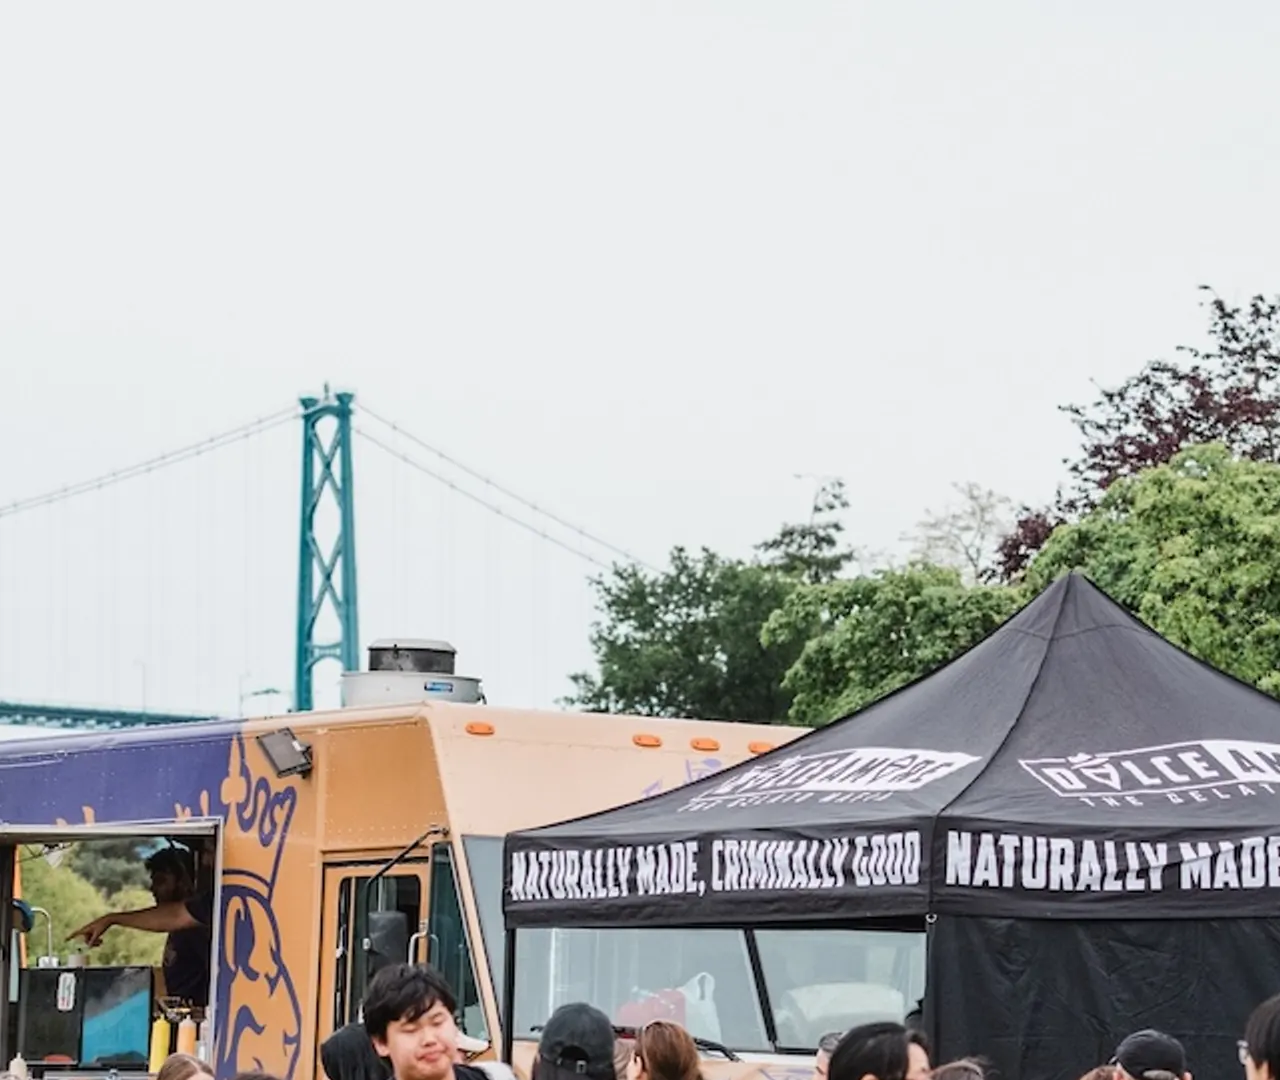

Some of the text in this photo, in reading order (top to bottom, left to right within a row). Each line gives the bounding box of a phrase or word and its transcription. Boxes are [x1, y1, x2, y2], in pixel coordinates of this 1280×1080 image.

[1042, 752, 1218, 790] DOLCE
[1079, 795, 1143, 807] THE
[510, 832, 920, 900] NATURALLY MADE, CRIMINALLY GOOD
[945, 830, 1168, 891] NATURALLY
